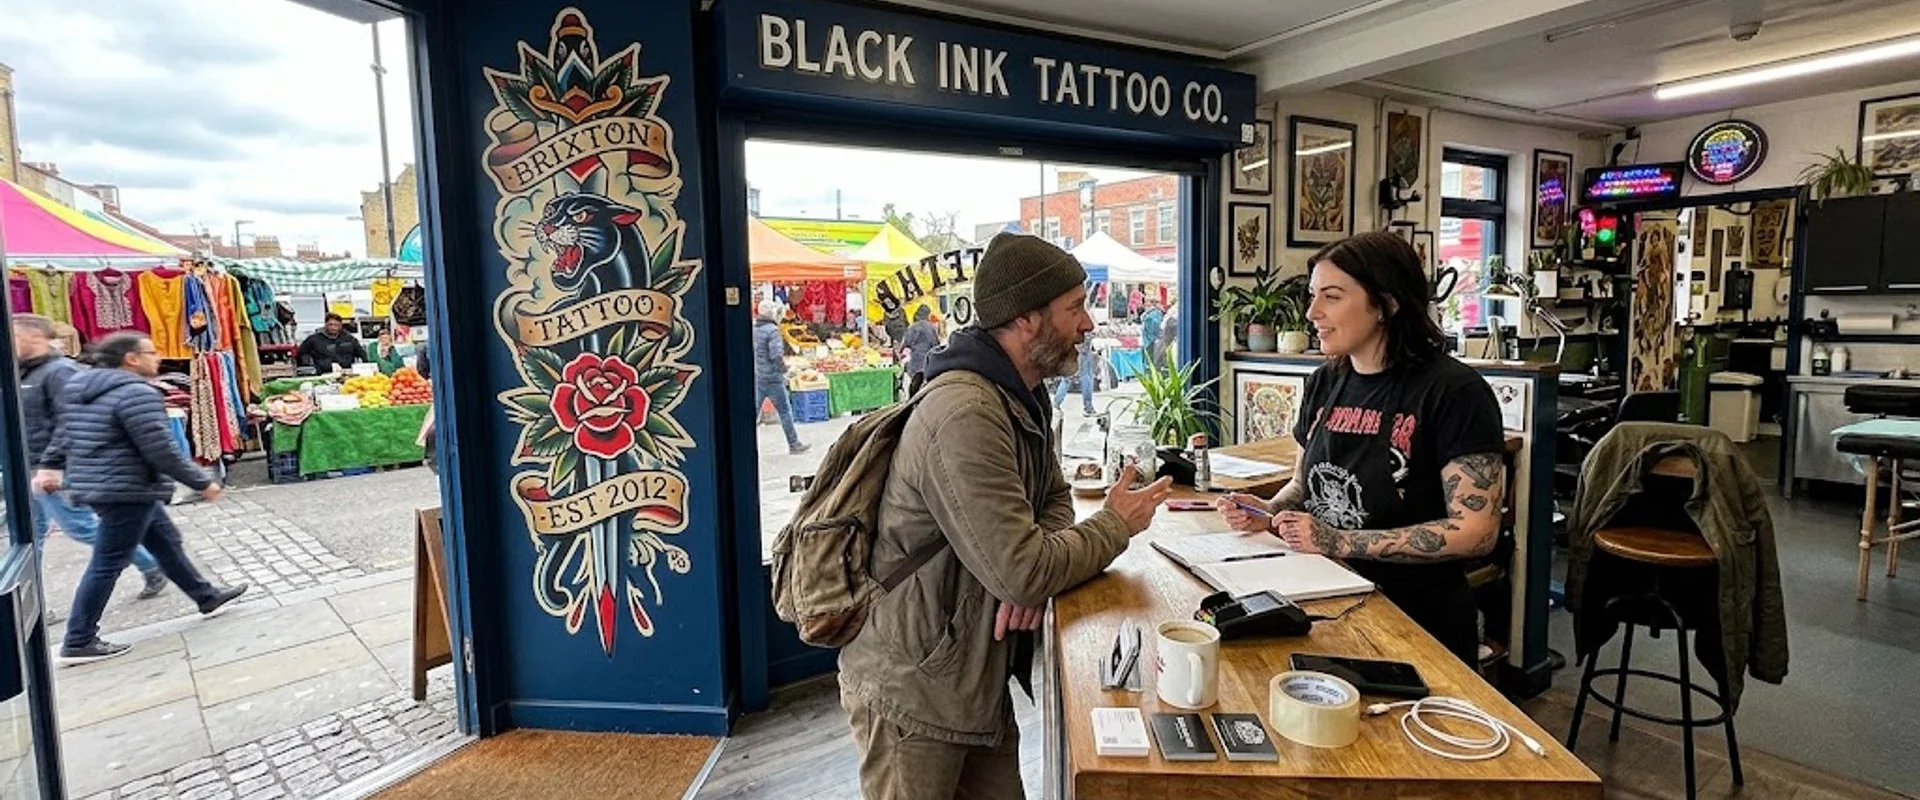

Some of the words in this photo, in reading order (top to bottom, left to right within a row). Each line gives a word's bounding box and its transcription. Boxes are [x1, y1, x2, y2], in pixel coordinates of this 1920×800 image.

[760, 13, 916, 86] BLACK
[938, 41, 1010, 97] INK
[1033, 56, 1171, 118] TATTOO
[1184, 80, 1229, 125] CO.
[512, 121, 650, 187] BRIXTON
[534, 294, 654, 341] TATTOO
[547, 492, 598, 529] EST
[606, 476, 667, 509] 2012
